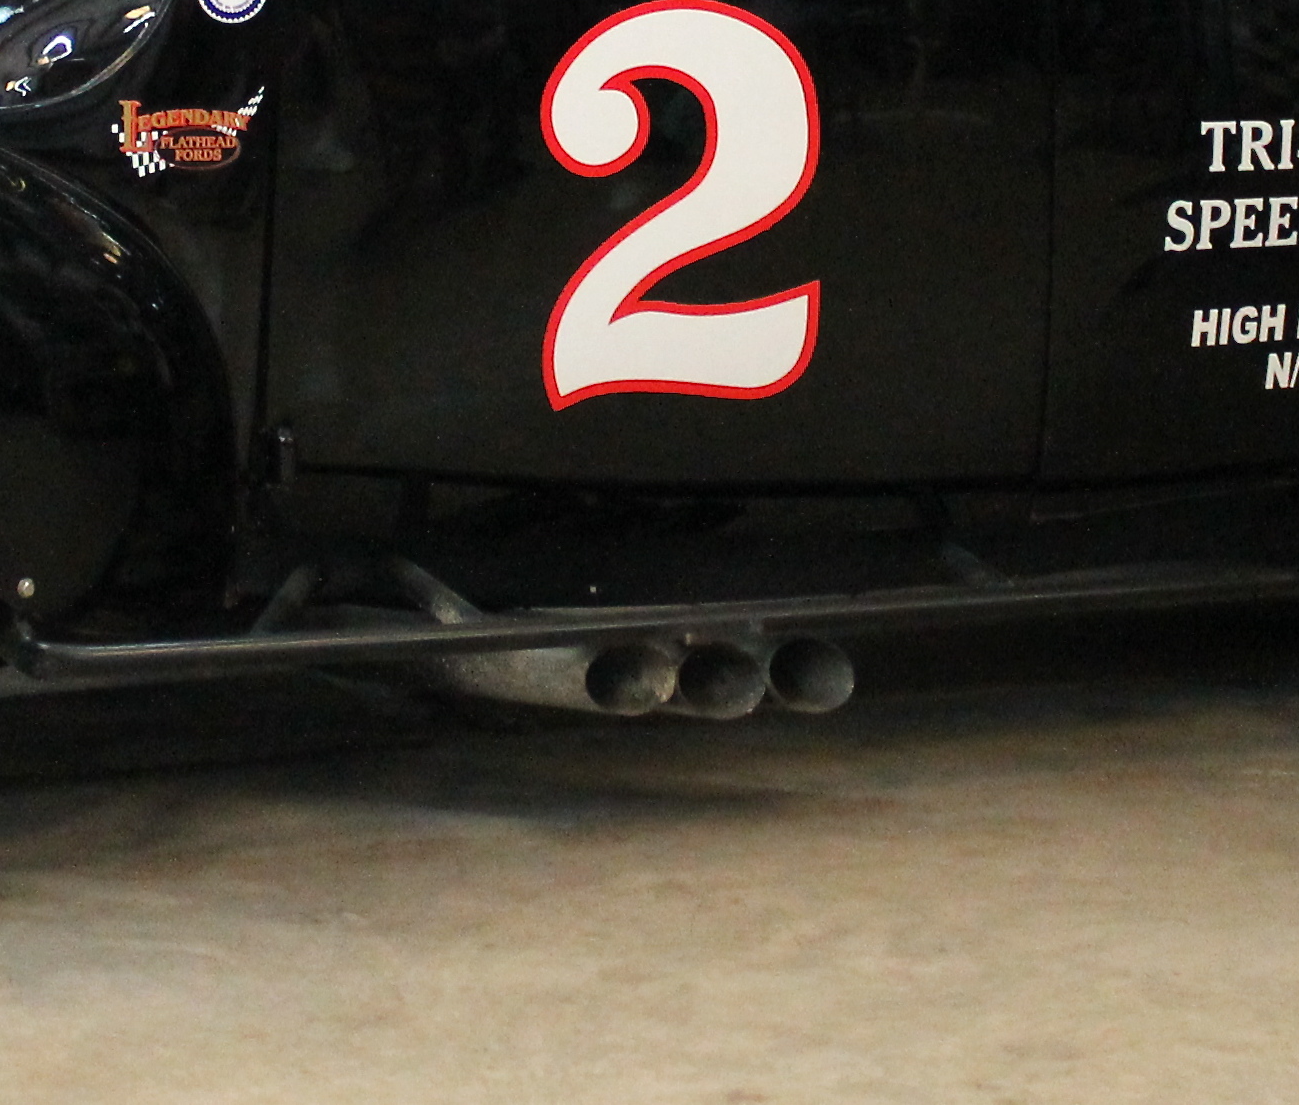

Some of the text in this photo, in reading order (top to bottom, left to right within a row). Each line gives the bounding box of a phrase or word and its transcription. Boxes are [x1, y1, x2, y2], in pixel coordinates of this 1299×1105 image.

[118, 99, 252, 154] LEGENDARY
[159, 135, 239, 150] FLATHEAD
[175, 148, 223, 162] FORDS
[1190, 303, 1287, 347] HIGH
